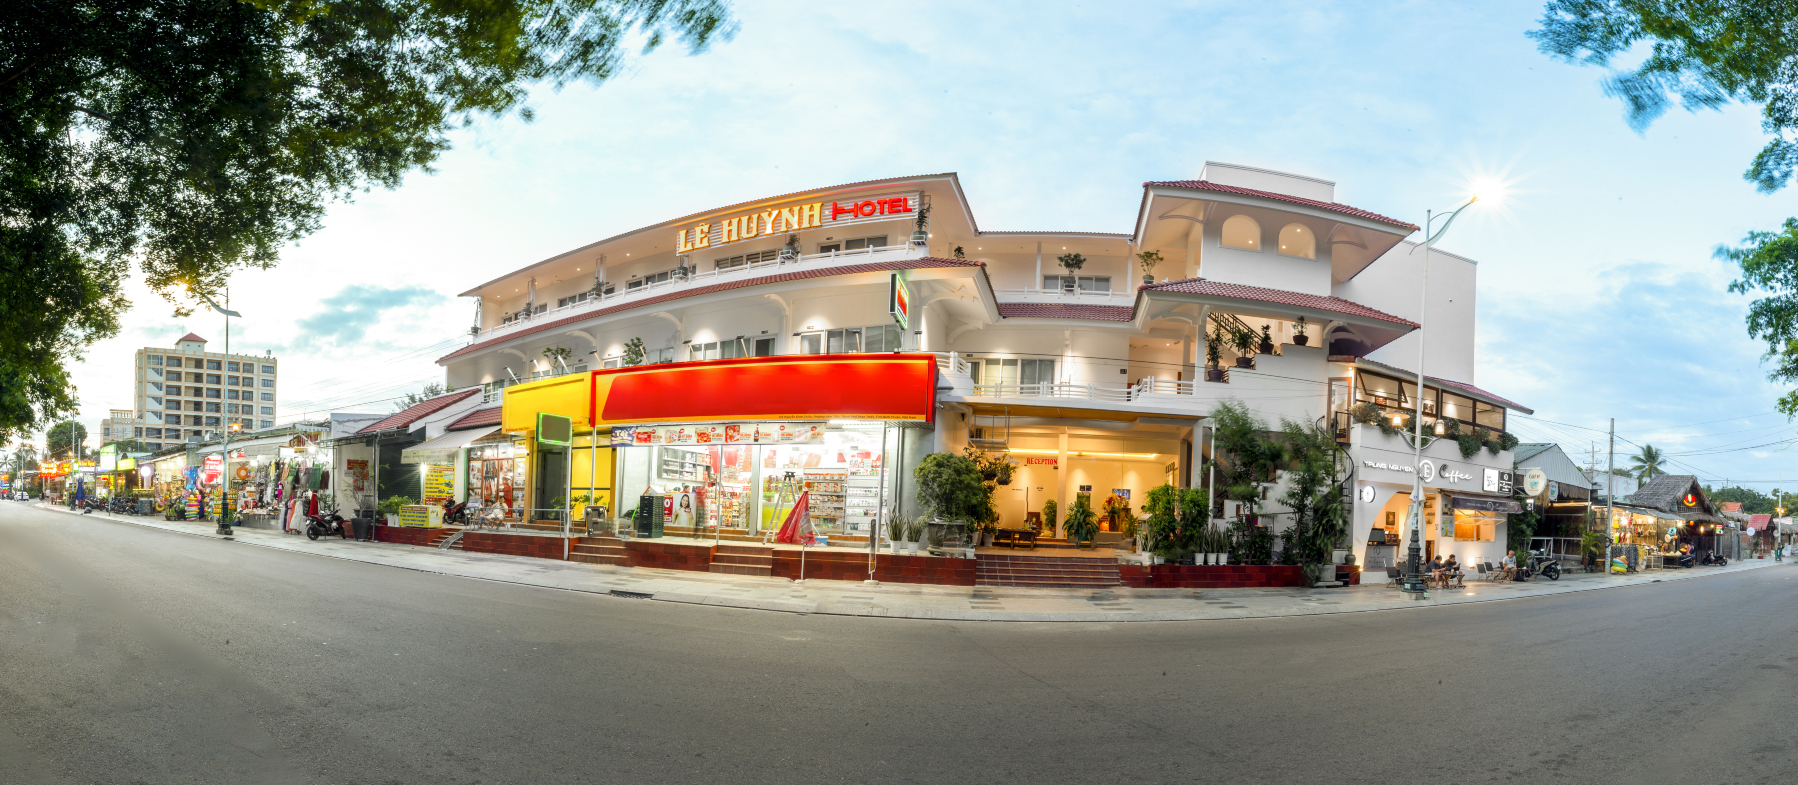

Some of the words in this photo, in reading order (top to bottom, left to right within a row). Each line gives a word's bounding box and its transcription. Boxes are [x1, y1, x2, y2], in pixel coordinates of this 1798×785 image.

[831, 197, 912, 220] HOTEL
[678, 222, 711, 253] LÊ
[721, 202, 823, 243] HUỲNH
[1363, 461, 1387, 469] TRUNG
[1439, 463, 1473, 483] Coffee
